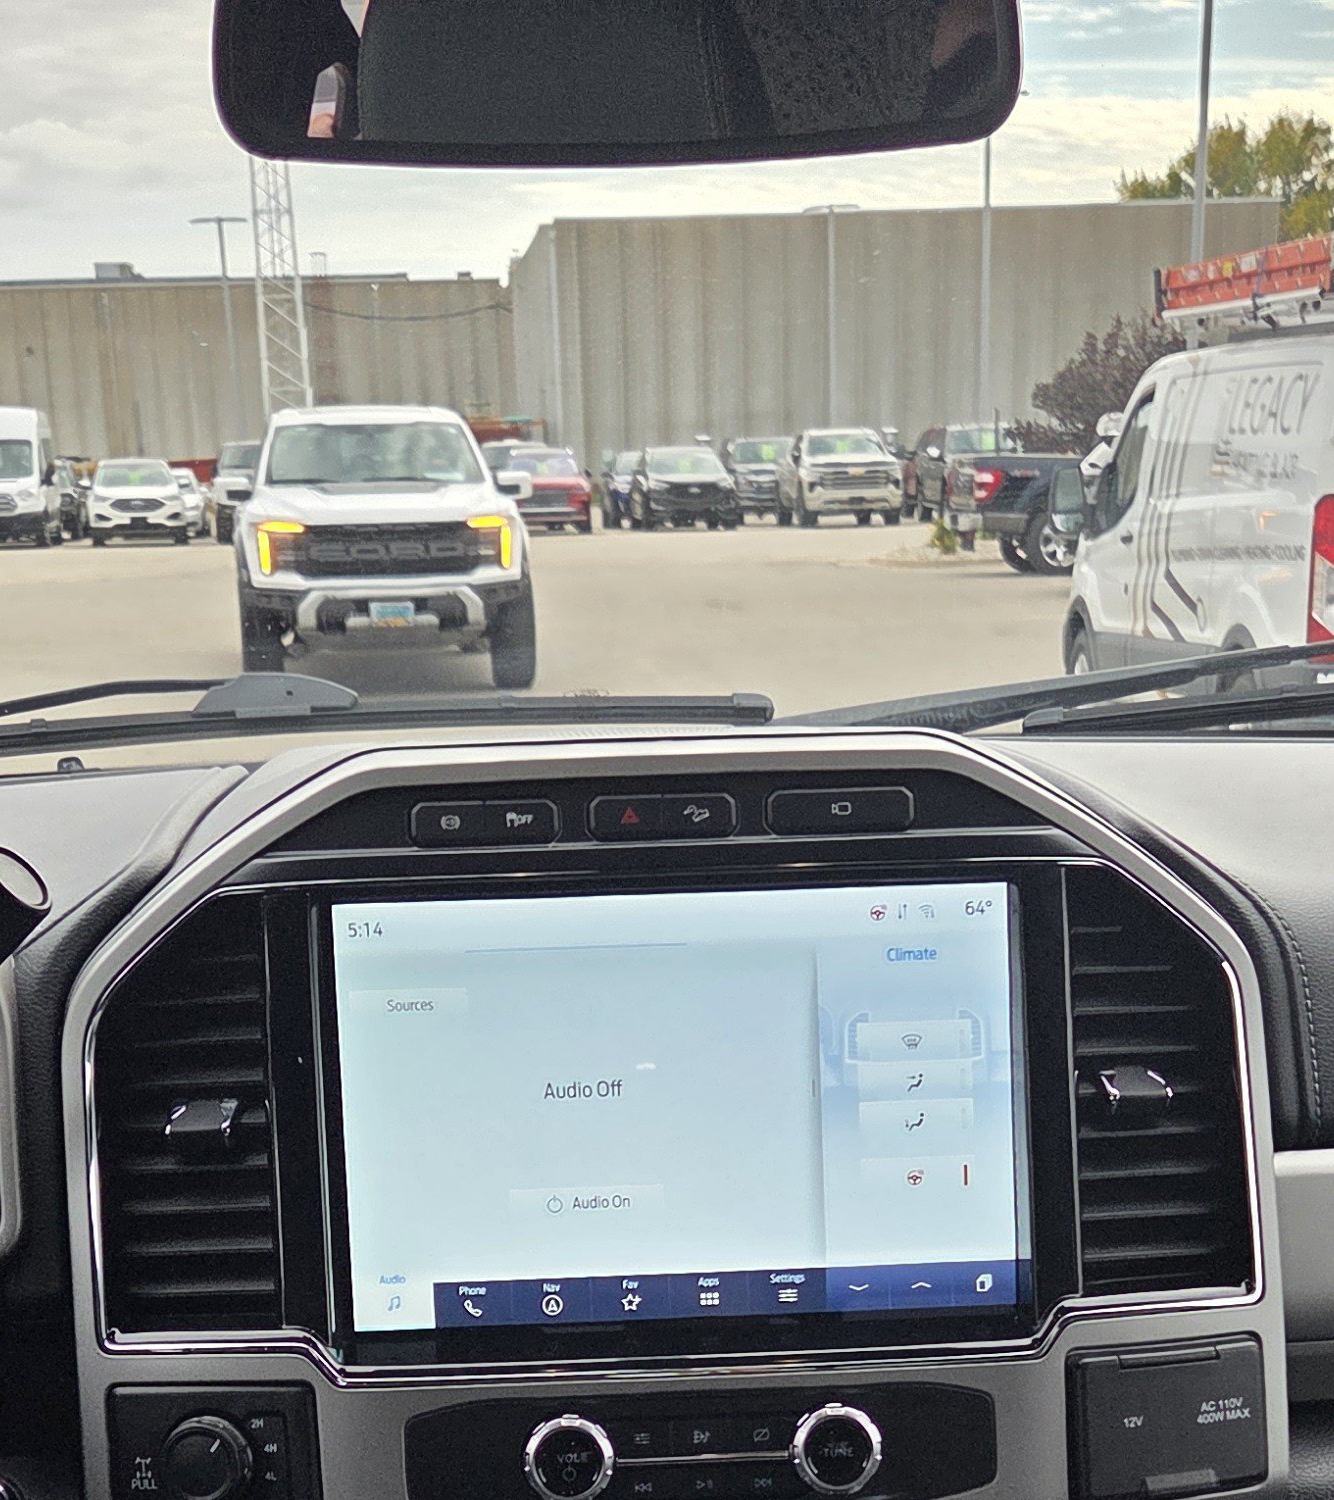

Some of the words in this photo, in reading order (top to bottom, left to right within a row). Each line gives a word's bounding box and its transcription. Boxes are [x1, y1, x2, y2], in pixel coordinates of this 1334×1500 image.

[348, 922, 384, 938] 5:14
[887, 947, 937, 962] Climate
[386, 999, 435, 1012] Sources
[544, 1081, 593, 1100] Audio
[597, 1079, 623, 1098] Off
[572, 1195, 610, 1210] Audio
[612, 1194, 631, 1208] On
[379, 1274, 407, 1286] Audio
[622, 1278, 639, 1290] Fav
[698, 1276, 720, 1288] Apps
[769, 1273, 806, 1285] Settings
[458, 1285, 487, 1297] Phone
[543, 1282, 561, 1293] Nav
[1200, 1400, 1216, 1413] AC
[1218, 1396, 1244, 1410] 110V
[1123, 1415, 1144, 1428] 12V
[1196, 1409, 1224, 1425] 400W
[1226, 1407, 1251, 1421] MAX
[250, 1417, 264, 1429] 2H
[263, 1442, 278, 1453] 4H
[264, 1471, 277, 1481] 4L
[131, 1479, 158, 1490] PULL
